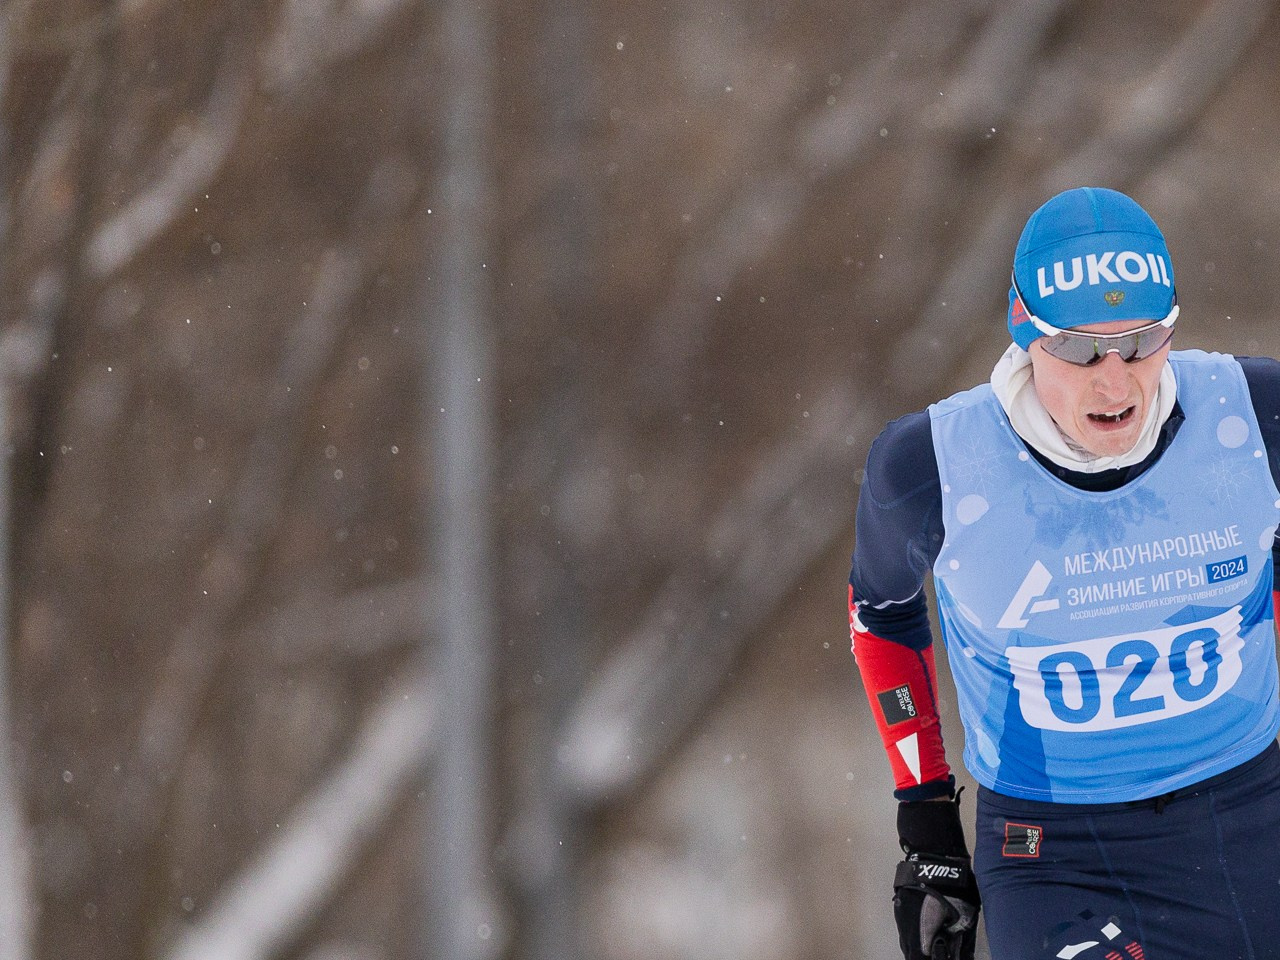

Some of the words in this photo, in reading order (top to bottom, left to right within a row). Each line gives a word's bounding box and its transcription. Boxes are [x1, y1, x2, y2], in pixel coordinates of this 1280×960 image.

[1037, 251, 1171, 298] LUKOIL
[1064, 524, 1243, 577] МЕЖДУНАРОДНЫЕ
[1067, 577, 1147, 606] ЗИМНИЕ
[1152, 568, 1205, 593] ИГРЫ
[1211, 558, 1244, 580] 2024
[1070, 605, 1120, 621] АССОЦИАЦИИ
[1120, 599, 1158, 613] РАЗВИТИЯ
[1159, 587, 1224, 606] КОРПОРАТИВНОГО
[1225, 578, 1249, 594] СПОРТА
[1038, 627, 1222, 724] 020
